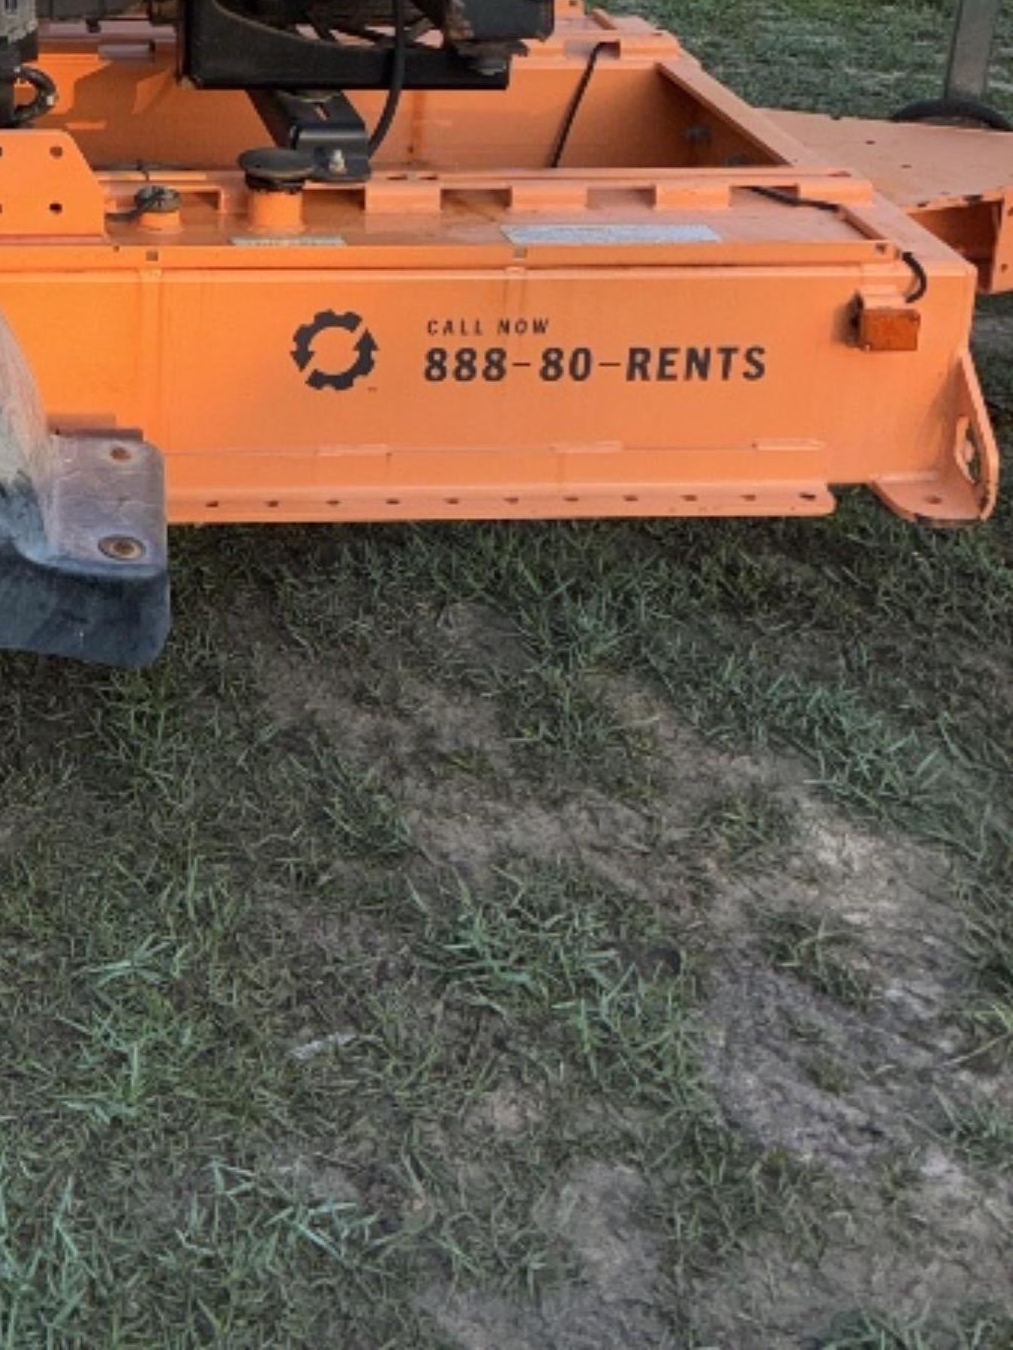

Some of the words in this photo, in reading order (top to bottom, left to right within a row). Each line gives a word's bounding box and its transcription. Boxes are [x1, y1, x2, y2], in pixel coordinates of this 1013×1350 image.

[426, 318, 485, 335] CALL
[496, 318, 550, 335] NOW
[423, 346, 767, 382] 888-80-RENTS
